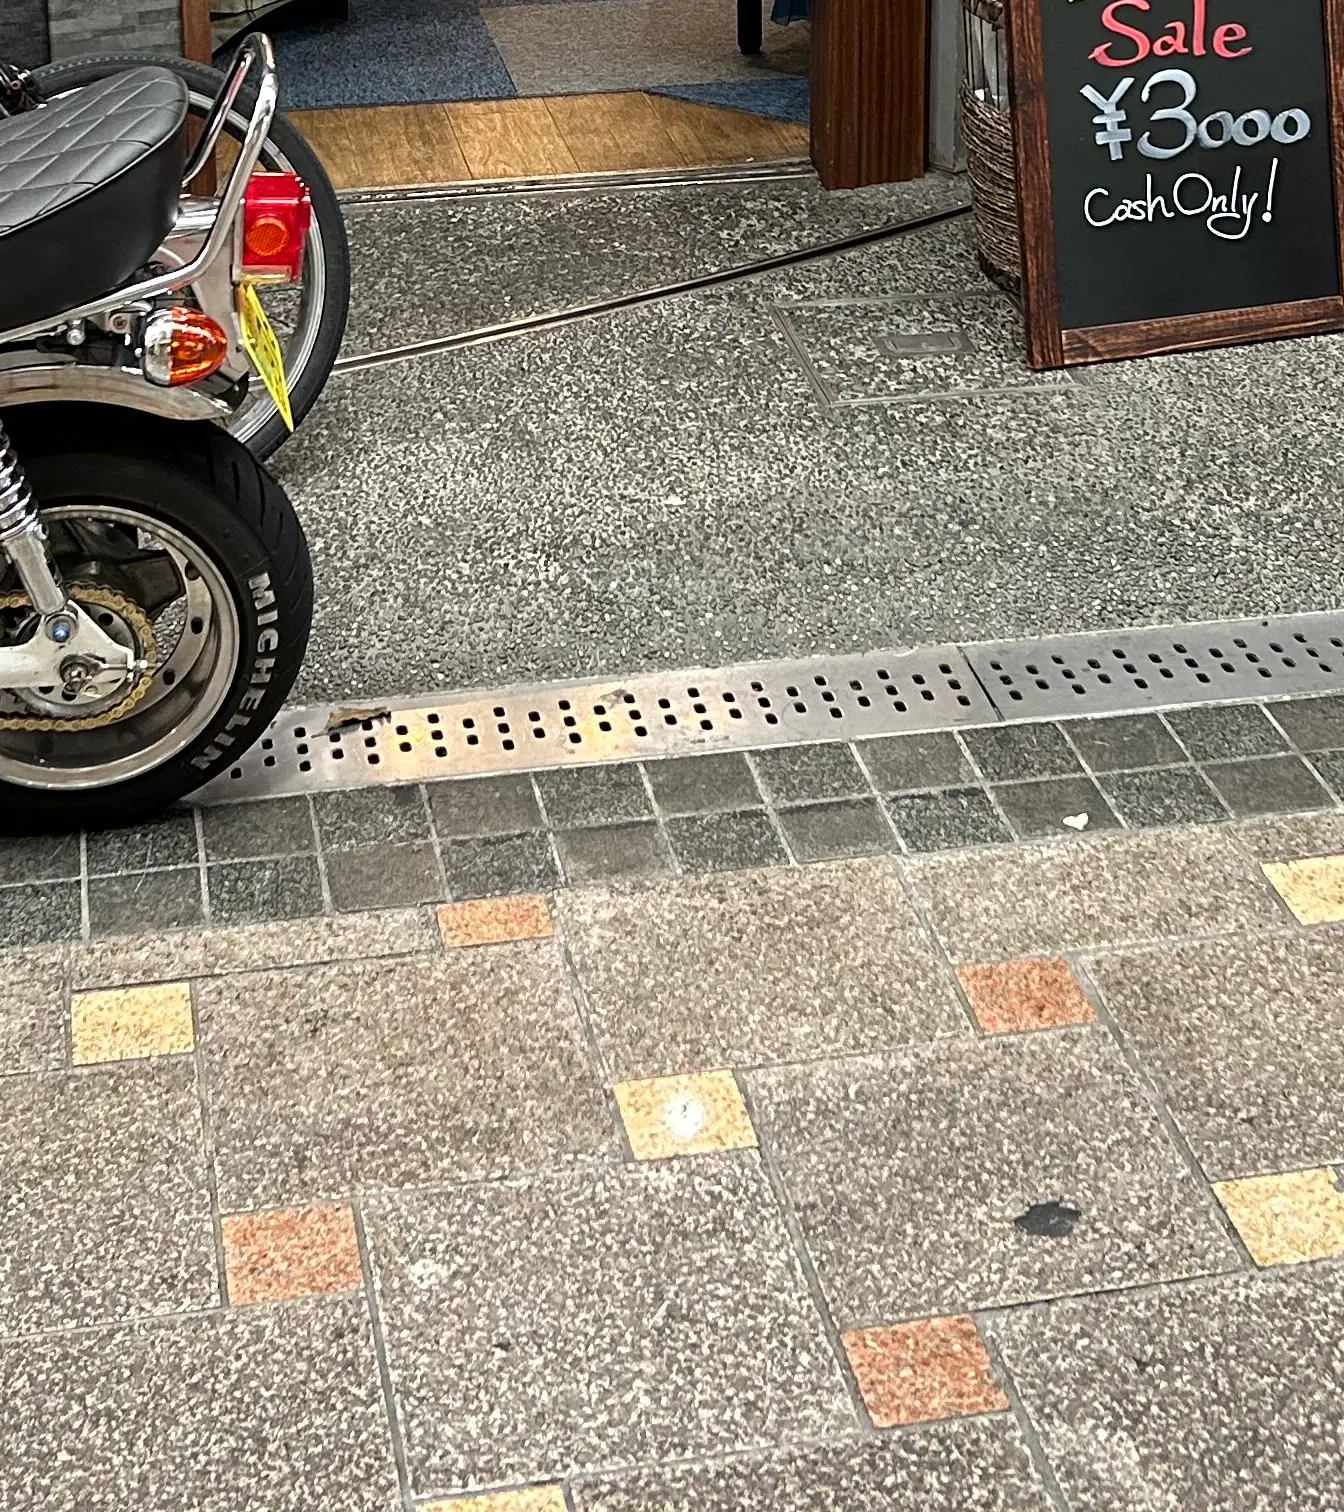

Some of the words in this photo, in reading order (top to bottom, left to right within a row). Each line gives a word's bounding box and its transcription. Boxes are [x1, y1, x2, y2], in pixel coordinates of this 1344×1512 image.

[1079, 69, 1312, 161] ¥3000
[1084, 173, 1175, 227] Cash
[1173, 157, 1279, 240] Only!
[190, 571, 279, 771] MICHELIN
